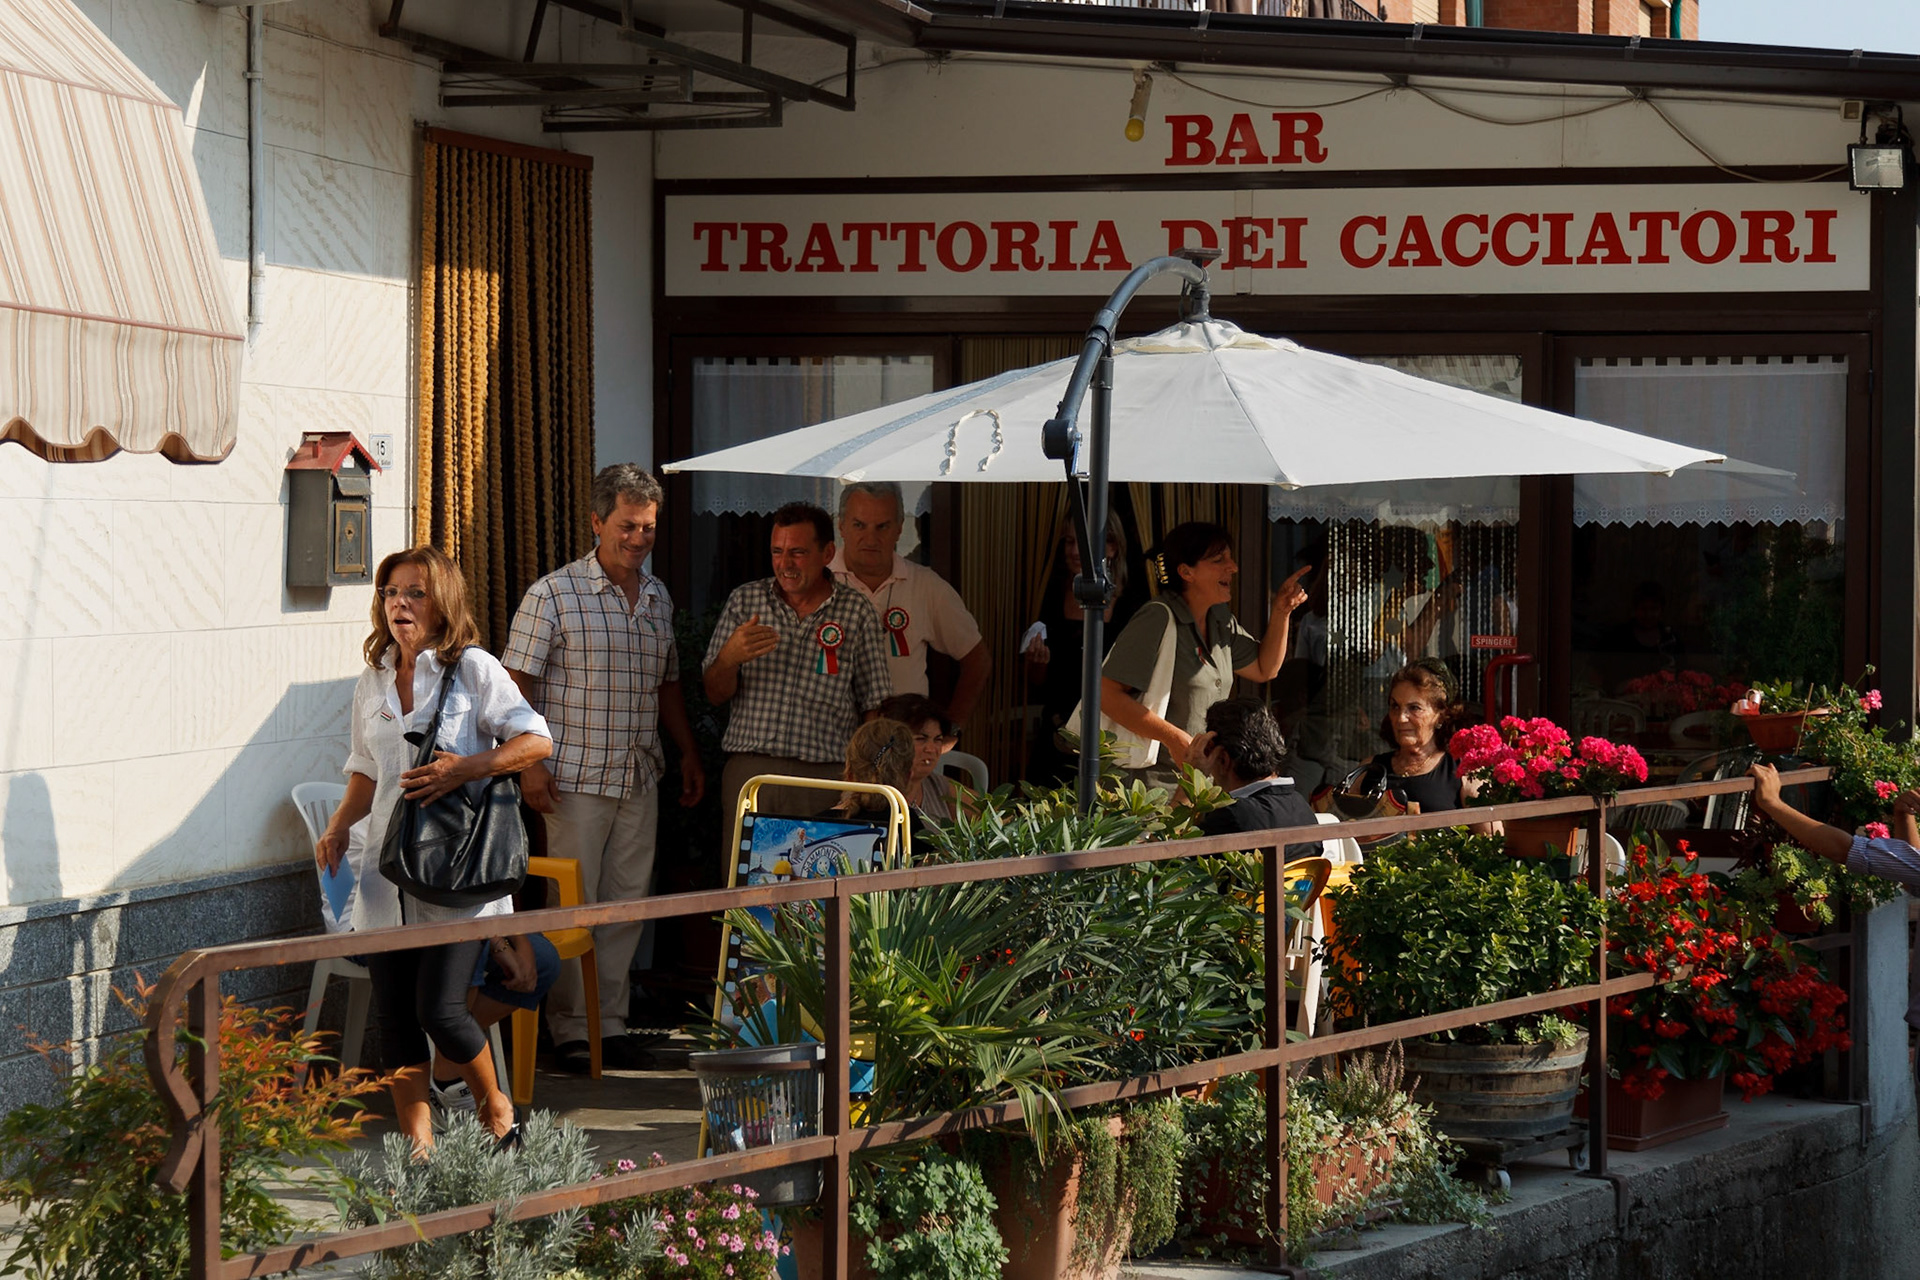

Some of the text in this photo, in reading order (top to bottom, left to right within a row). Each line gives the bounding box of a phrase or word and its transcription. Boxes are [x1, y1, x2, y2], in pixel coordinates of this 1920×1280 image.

[1165, 112, 1328, 165] BAR
[695, 210, 1838, 272] TRATTORIA DEI CACCIATORI
[376, 440, 386, 456] 15
[1475, 637, 1512, 646] SPINGERE
